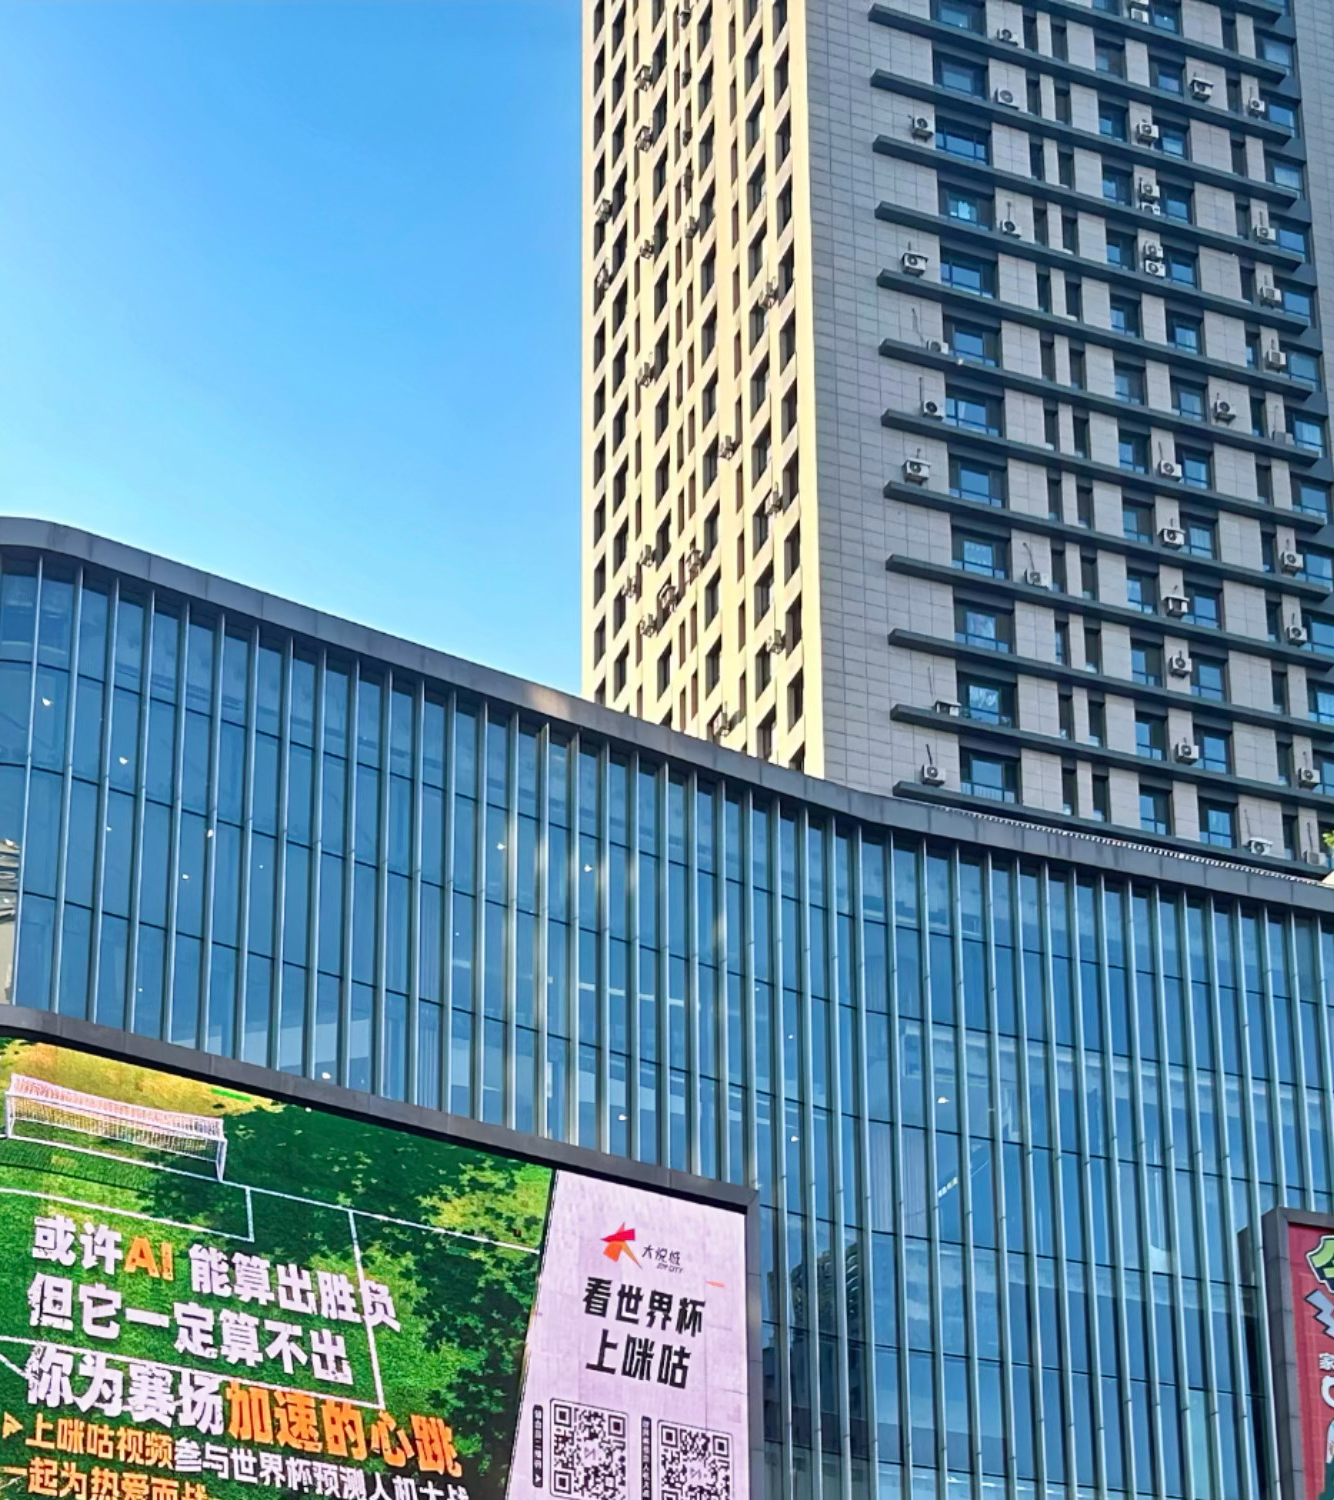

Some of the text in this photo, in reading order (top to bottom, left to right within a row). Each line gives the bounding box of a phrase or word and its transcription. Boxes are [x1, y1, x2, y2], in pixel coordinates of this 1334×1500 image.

[32, 1215, 400, 1332] 或许AI 能算出胜负
[641, 1245, 682, 1266] 大悦城
[27, 1272, 354, 1386] 但它一定算不出
[582, 1276, 706, 1338] 看世界杯
[585, 1328, 692, 1390] 上咪咕
[26, 1343, 463, 1478] 你为赛场加速的心跳
